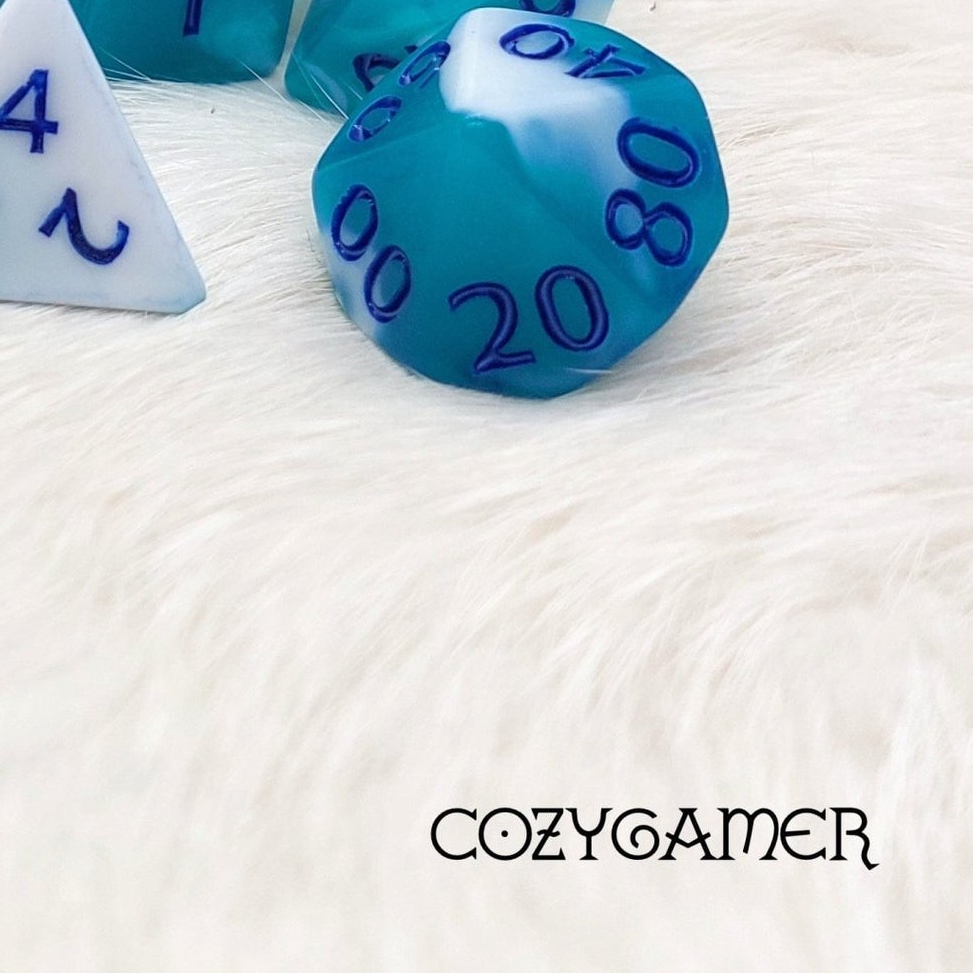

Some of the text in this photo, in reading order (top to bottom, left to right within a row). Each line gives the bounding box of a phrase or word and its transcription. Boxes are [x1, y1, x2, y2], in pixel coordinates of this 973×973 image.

[499, 23, 648, 81] 40
[38, 187, 130, 266] 2
[605, 116, 700, 268] 80
[330, 183, 413, 324] 00
[447, 264, 610, 376] 20
